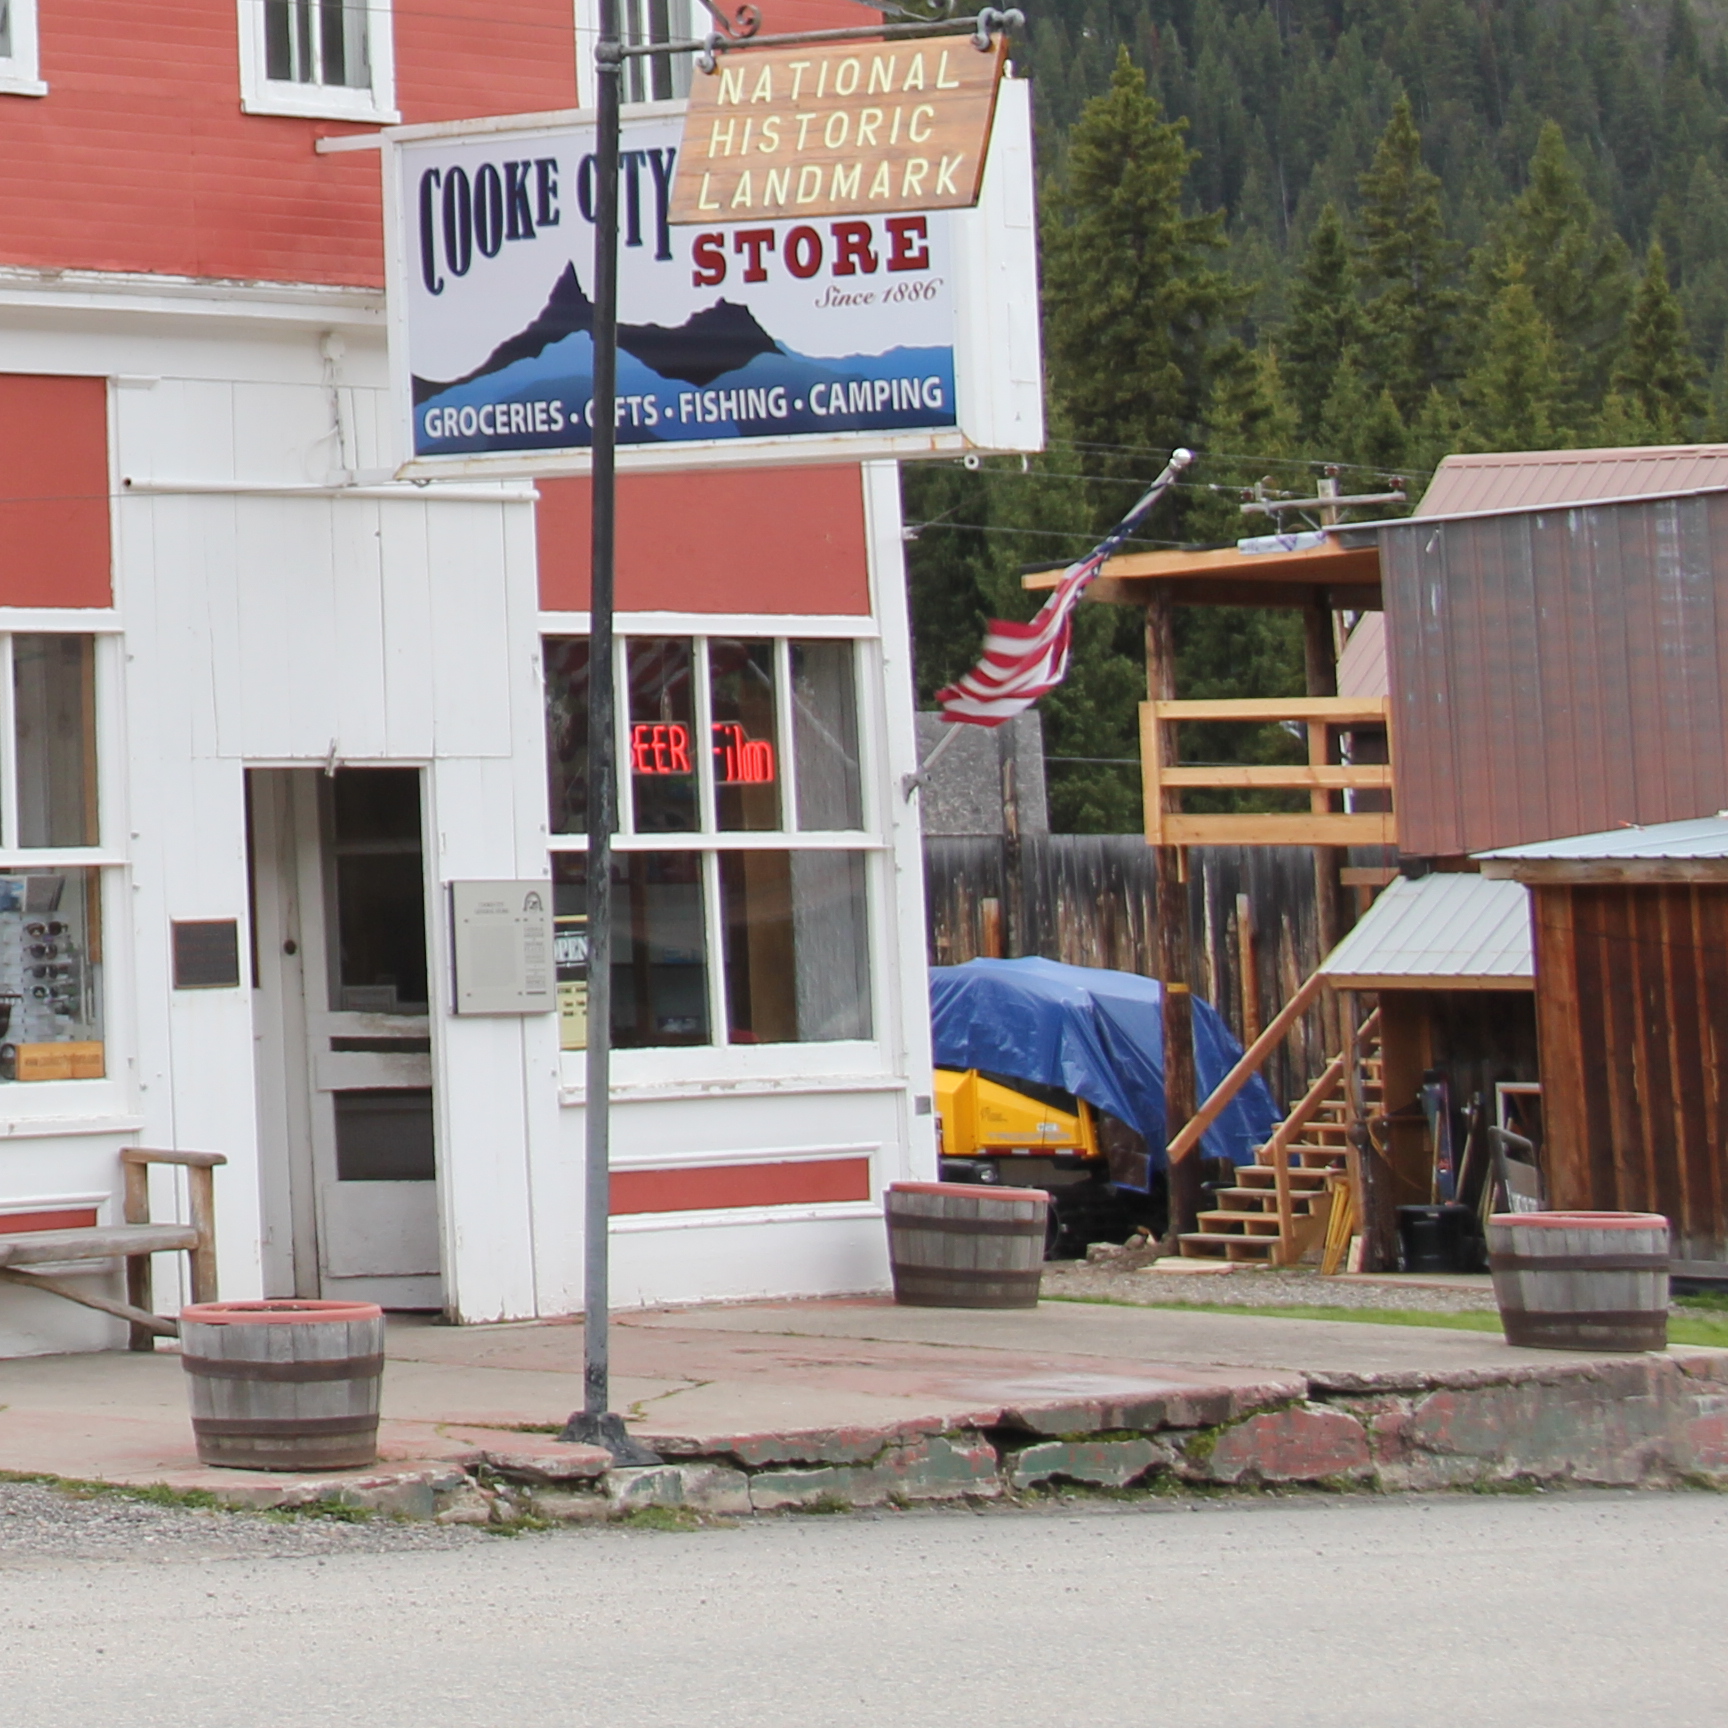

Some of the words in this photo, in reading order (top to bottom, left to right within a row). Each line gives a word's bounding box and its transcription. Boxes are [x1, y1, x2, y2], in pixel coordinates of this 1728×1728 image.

[717, 50, 960, 105] NATIONAL
[707, 103, 935, 158] HISTORIC
[698, 152, 964, 210] LANDMARK
[419, 157, 560, 295] COOKE
[576, 147, 677, 262] CTY
[691, 215, 930, 288] STORE
[814, 284, 875, 309] Since
[882, 278, 944, 304] 1886
[424, 399, 565, 438] GROCERIES
[678, 386, 788, 423] FISHING
[808, 375, 944, 417] CAMPING
[630, 725, 691, 774] EER
